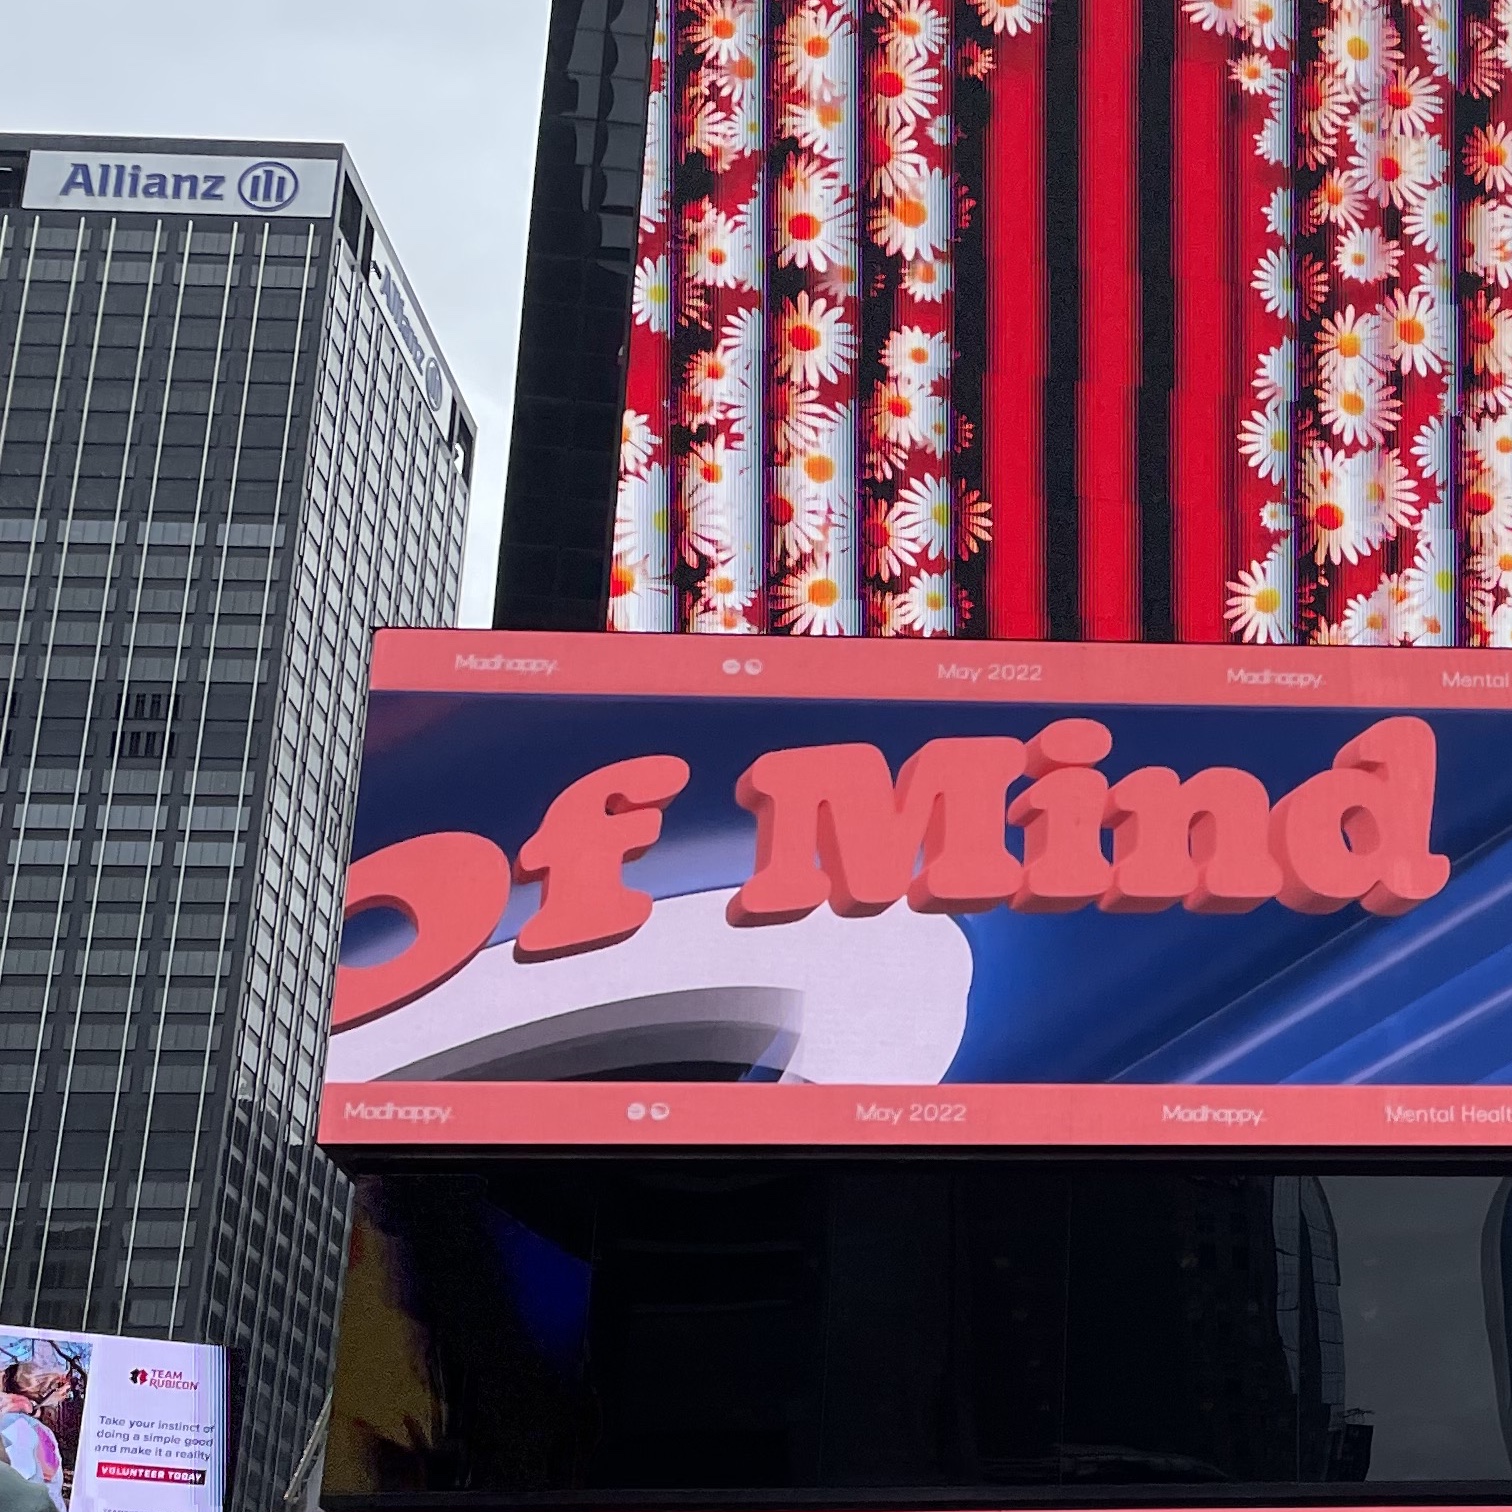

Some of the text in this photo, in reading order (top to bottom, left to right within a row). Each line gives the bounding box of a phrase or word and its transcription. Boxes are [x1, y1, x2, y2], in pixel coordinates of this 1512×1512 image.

[59, 162, 226, 201] Allianz
[937, 663, 1043, 683] May 2022
[1442, 671, 1509, 689] Mental
[331, 716, 1451, 1034] Of Mind
[856, 1102, 967, 1124] May 2022
[1386, 1104, 1455, 1124] Mental
[151, 1368, 183, 1380] TEAM
[149, 1378, 199, 1391] RUBICON
[99, 1415, 216, 1433] Take your instinct of
[96, 1429, 130, 1442] doing
[143, 1432, 182, 1446] simple
[184, 1437, 214, 1448] good
[94, 1443, 211, 1462] and make it a reality
[101, 1466, 202, 1481] VOLUNTEER TODAY
